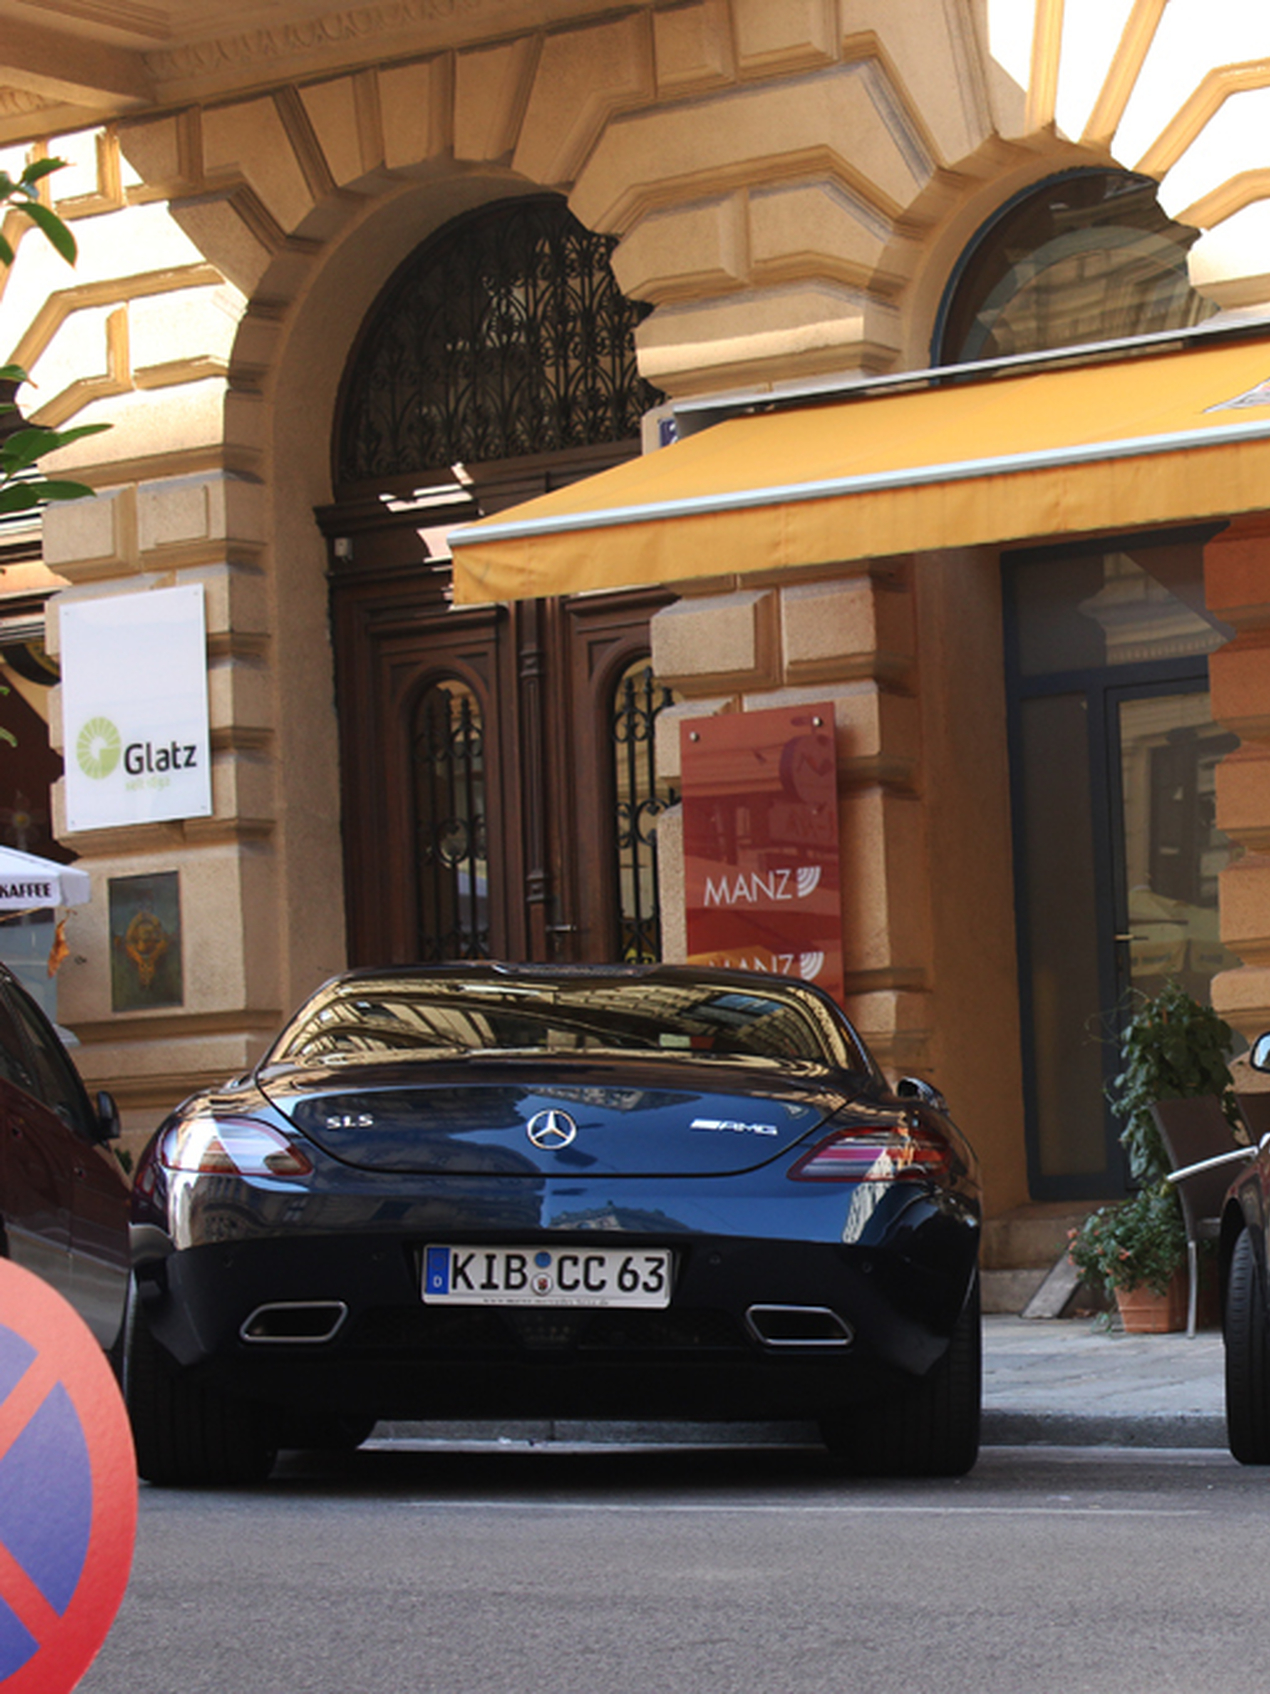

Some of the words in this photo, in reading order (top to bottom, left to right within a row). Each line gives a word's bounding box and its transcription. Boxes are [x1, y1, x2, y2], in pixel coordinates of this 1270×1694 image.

[124, 742, 197, 775] Glatz
[0, 882, 52, 898] KAFFEE
[704, 870, 792, 905] MANZ
[326, 1113, 374, 1130] SLS
[719, 1120, 778, 1135] AMG
[452, 1253, 529, 1291] KIB
[557, 1255, 607, 1292] CC
[617, 1256, 665, 1293] 63
